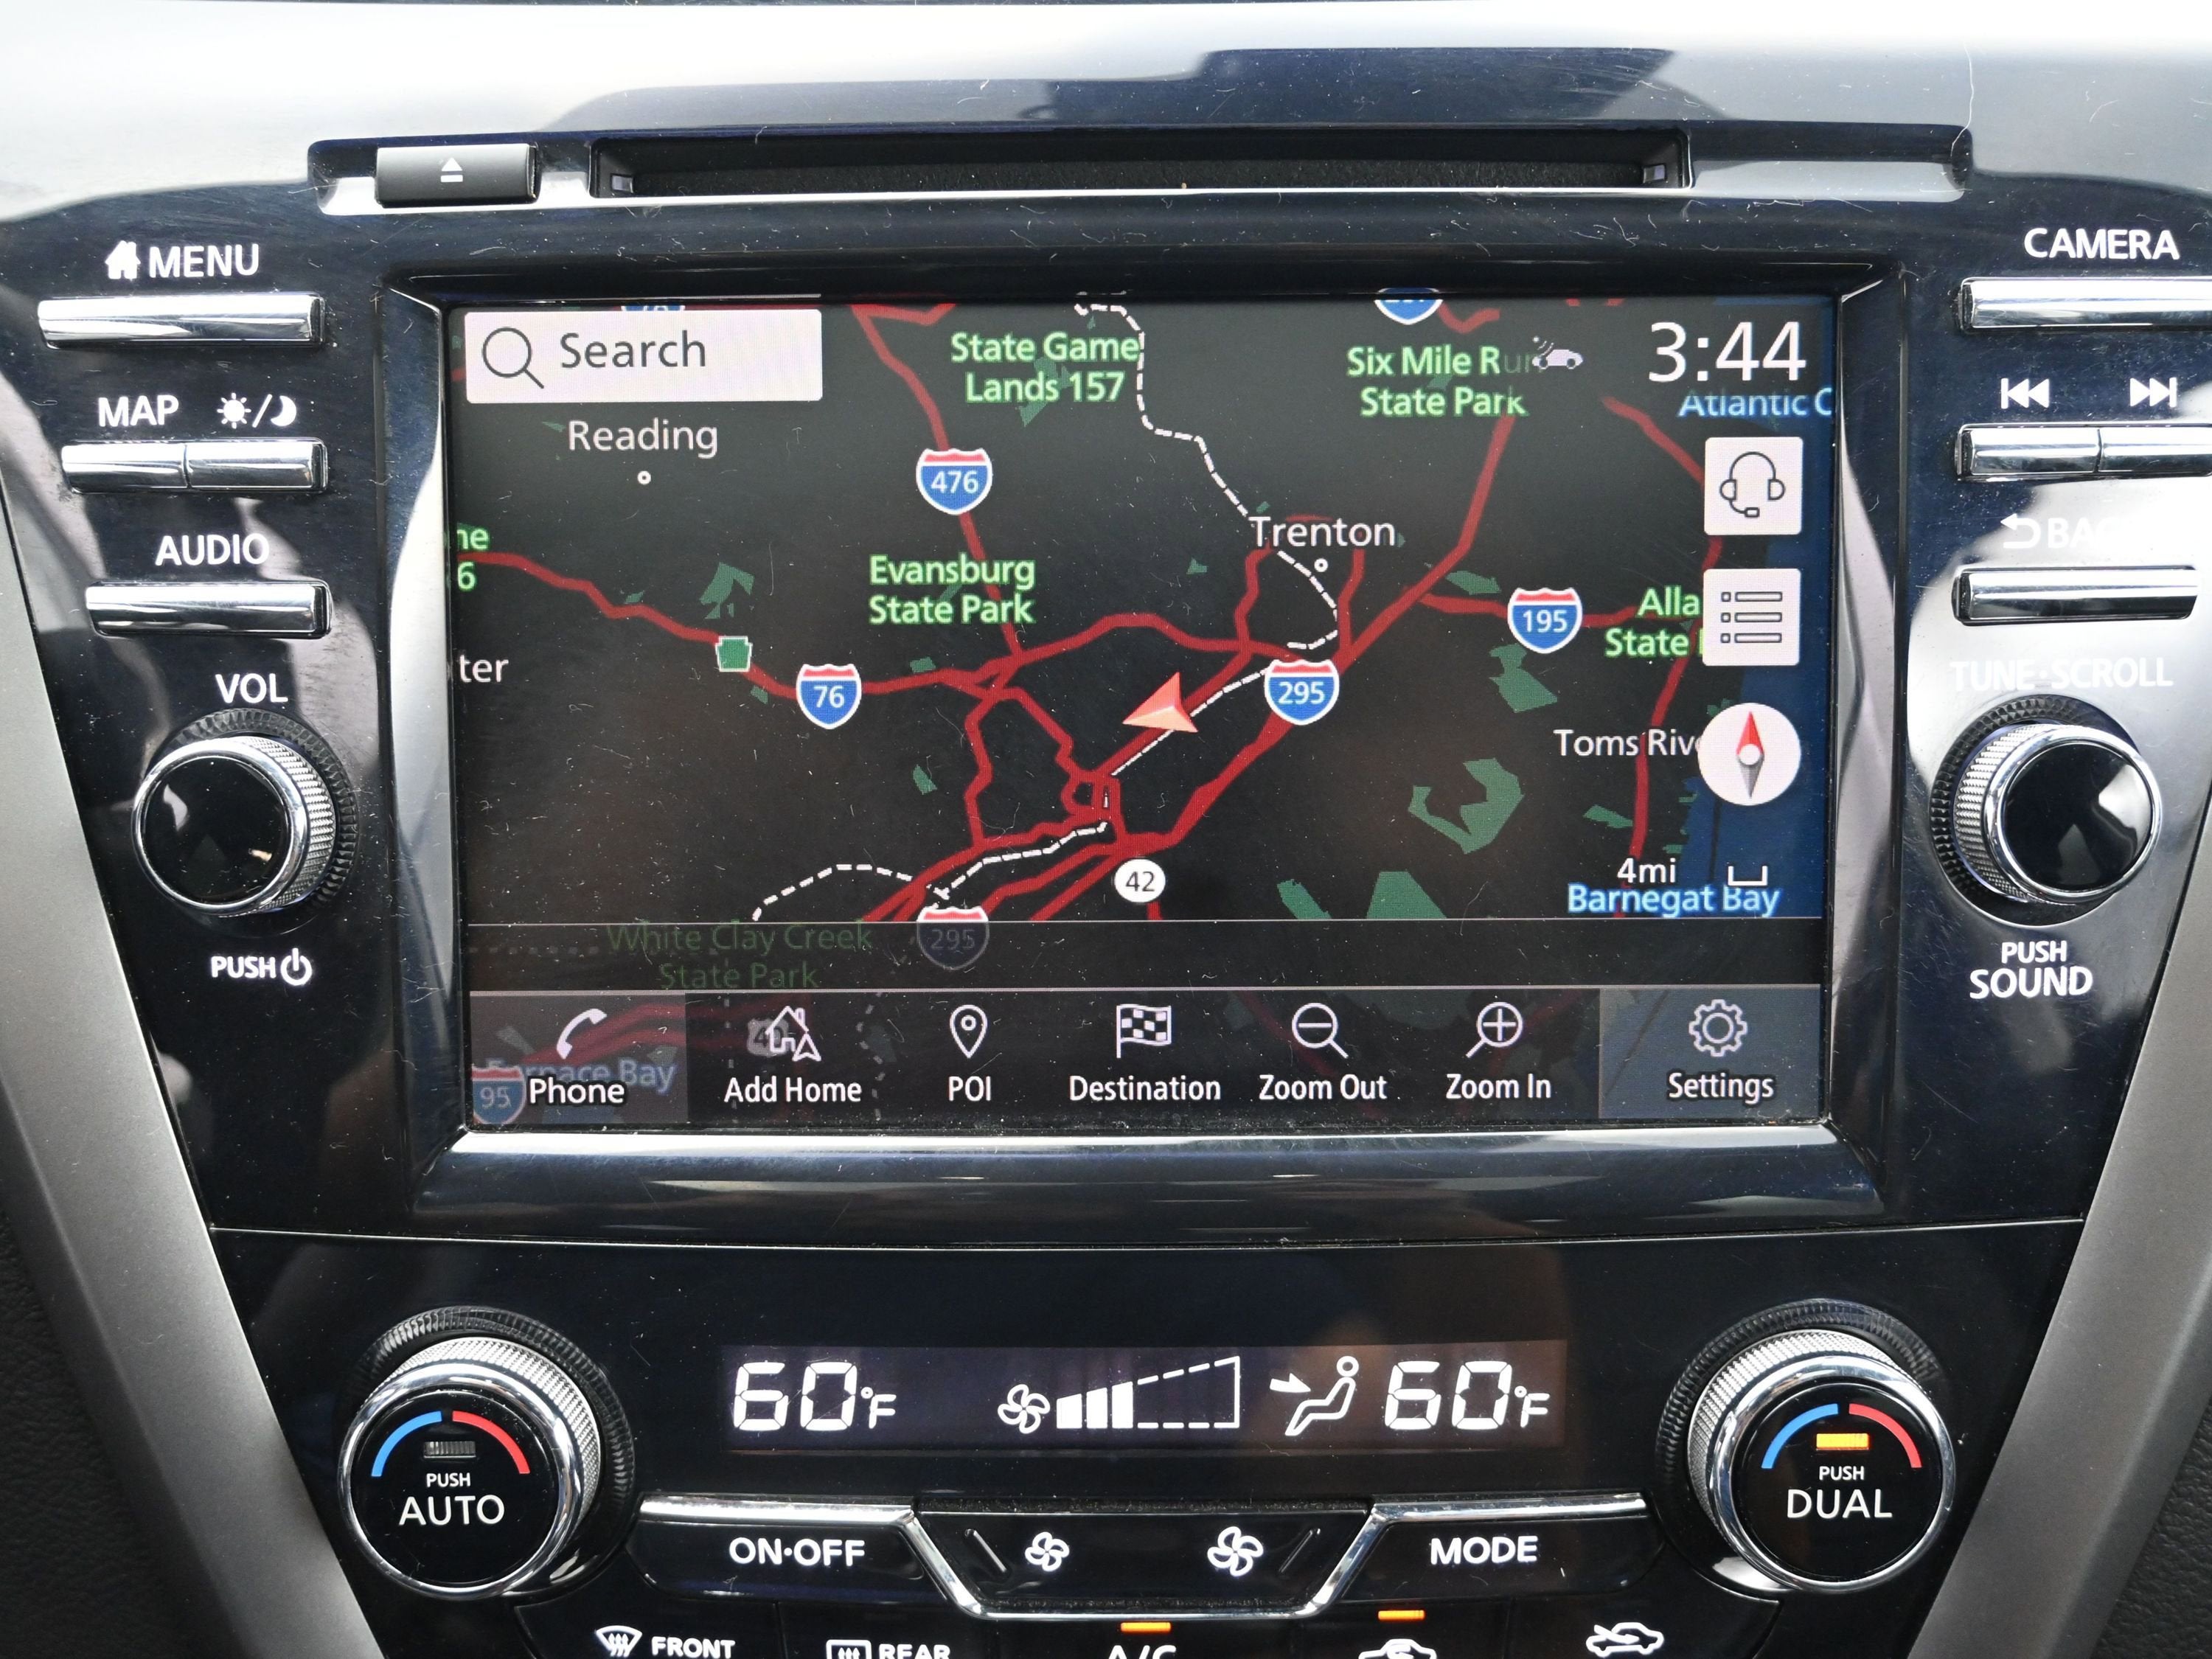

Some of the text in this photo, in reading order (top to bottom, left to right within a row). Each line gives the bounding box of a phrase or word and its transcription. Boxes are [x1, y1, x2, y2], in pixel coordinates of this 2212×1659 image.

[2023, 228, 2180, 260] CAMERA
[149, 244, 260, 278] MENU
[560, 330, 707, 369] Search
[951, 332, 1140, 364] State Game
[1347, 346, 1394, 376] Six
[1402, 344, 1472, 375] Mile
[1648, 321, 1806, 383] 3:44
[965, 371, 1124, 403] Lands 157
[1360, 386, 1526, 418] State Park
[98, 394, 179, 427] MAP
[1677, 389, 1807, 417] Atlantic
[568, 417, 718, 459] Reading
[931, 470, 978, 494] 476
[1249, 517, 1396, 547] Trenton
[2048, 517, 2138, 549] BAC
[155, 533, 269, 566] AUDIO
[457, 562, 476, 591] 6
[869, 553, 1036, 590] Evansburg
[869, 594, 1034, 625] State Park
[1638, 585, 1700, 618] Alla
[1523, 609, 1568, 633] 195
[1605, 628, 1689, 658] State
[459, 655, 509, 683] ter
[216, 673, 288, 703] VOL
[813, 686, 845, 709] 76
[1278, 681, 1325, 706] 295
[1554, 728, 1702, 757] Toms Riv
[1126, 872, 1155, 892] 42
[1617, 858, 1677, 883] 4mi
[1568, 883, 1781, 919] Barnegat Bay
[606, 919, 873, 955] White Clay Creek
[931, 928, 975, 951] 295
[211, 956, 276, 979] PUSH
[2001, 941, 2067, 964] PUSH
[661, 961, 819, 990] State Park
[1969, 966, 2093, 1000] SOUND
[529, 1077, 625, 1105] Phone
[619, 1059, 678, 1094] Bay
[724, 1077, 862, 1103] Add Home
[948, 1076, 991, 1102] POI
[1070, 1075, 1222, 1102] Destination
[1259, 1074, 1388, 1100] Zoom Out
[1446, 1074, 1551, 1099] Zoom In
[1669, 1072, 1775, 1105] Settings
[479, 1086, 512, 1110] 95
[734, 1361, 897, 1431] 60°F
[1385, 1360, 1550, 1430] 60°F
[426, 1473, 471, 1488] PUSH
[1819, 1466, 1865, 1481] PUSH
[399, 1495, 505, 1526] AUTO
[1787, 1489, 1893, 1520] DUAL
[1430, 1536, 1538, 1565] MODE
[651, 1637, 735, 1659] FRONT
[879, 1644, 951, 1659] REAR
